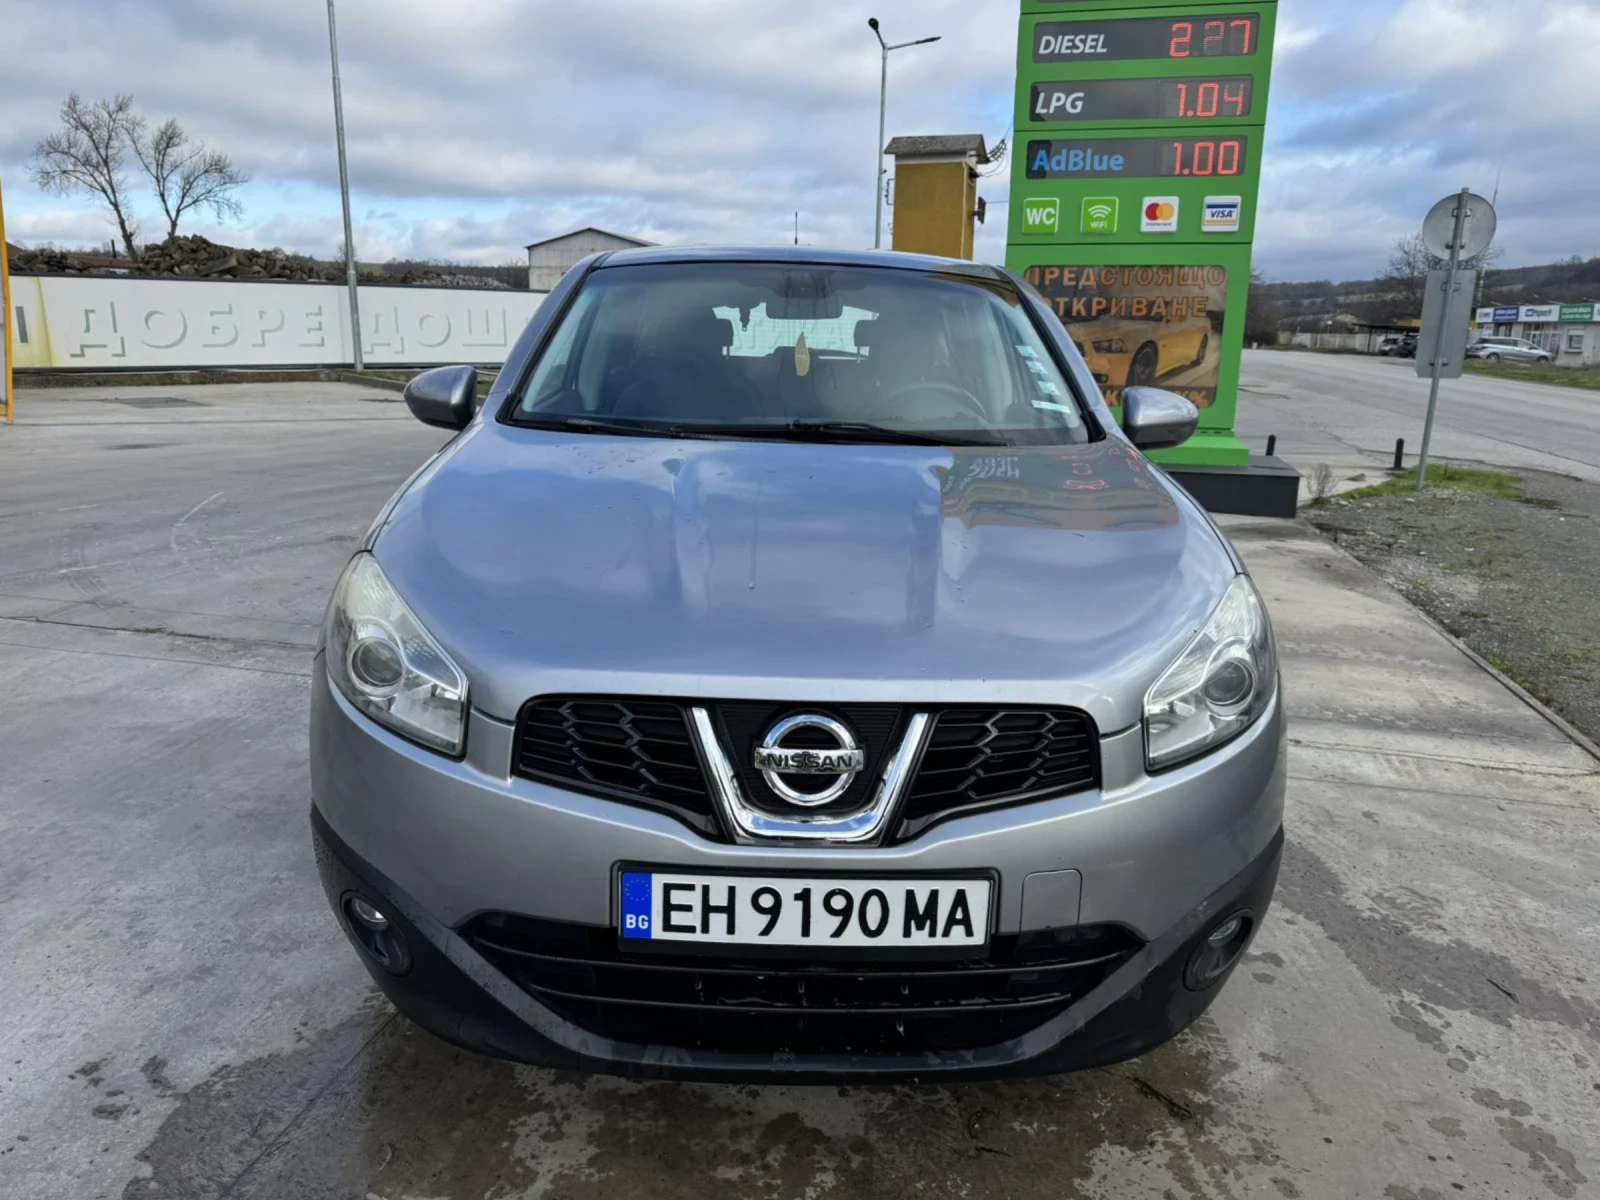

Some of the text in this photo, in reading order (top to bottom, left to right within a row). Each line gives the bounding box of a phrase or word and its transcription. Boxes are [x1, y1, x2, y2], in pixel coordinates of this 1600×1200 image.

[1038, 34, 1108, 54] DIESEL
[1035, 82, 1244, 117] LPG 1.04
[1031, 141, 1239, 176] AdBlue 1.00
[1026, 208, 1056, 225] WC
[1210, 209, 1233, 218] VISA
[1025, 266, 1226, 289] ПРЕДСТОЯЩО
[69, 302, 326, 358] ДОБРЕ
[363, 306, 530, 354] ДОШ
[766, 753, 852, 768] NISSAN
[661, 882, 974, 938] EH 9190 MA
[626, 914, 649, 930] BG
